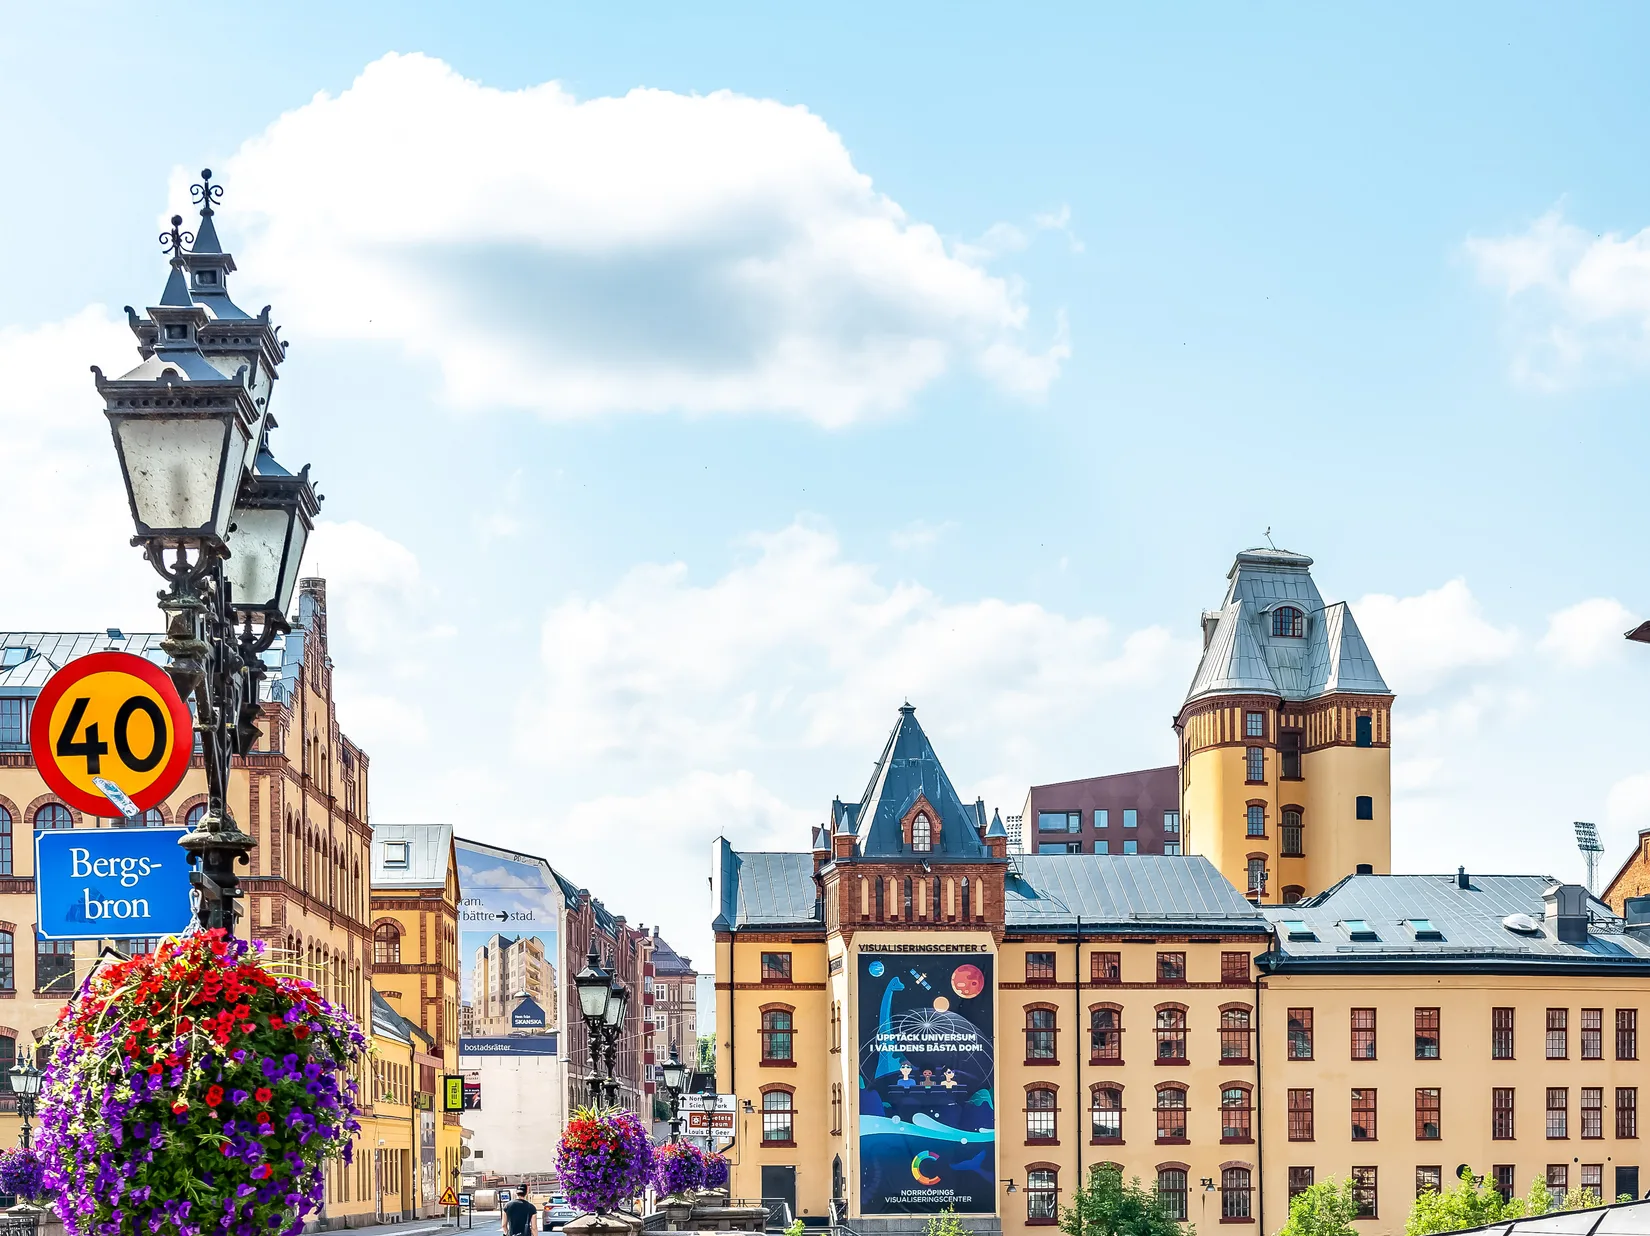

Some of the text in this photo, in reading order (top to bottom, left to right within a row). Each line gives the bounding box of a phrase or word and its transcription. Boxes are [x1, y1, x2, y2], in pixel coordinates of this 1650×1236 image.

[56, 695, 167, 775] 40
[69, 848, 163, 887] Bergs-
[82, 887, 151, 920] bron
[459, 898, 484, 906] ram.
[462, 911, 495, 921] bättre
[510, 910, 536, 921] stad.
[858, 944, 987, 952] VISUALISERINGSCENTER C
[876, 1032, 976, 1041] UPPTÄCK UNIVERSUM
[464, 1043, 511, 1051] bostadsrätter
[869, 1042, 983, 1052] I VÄRLDENS BÄSTA DOM!
[900, 1188, 955, 1196] NORRKÖPINGS
